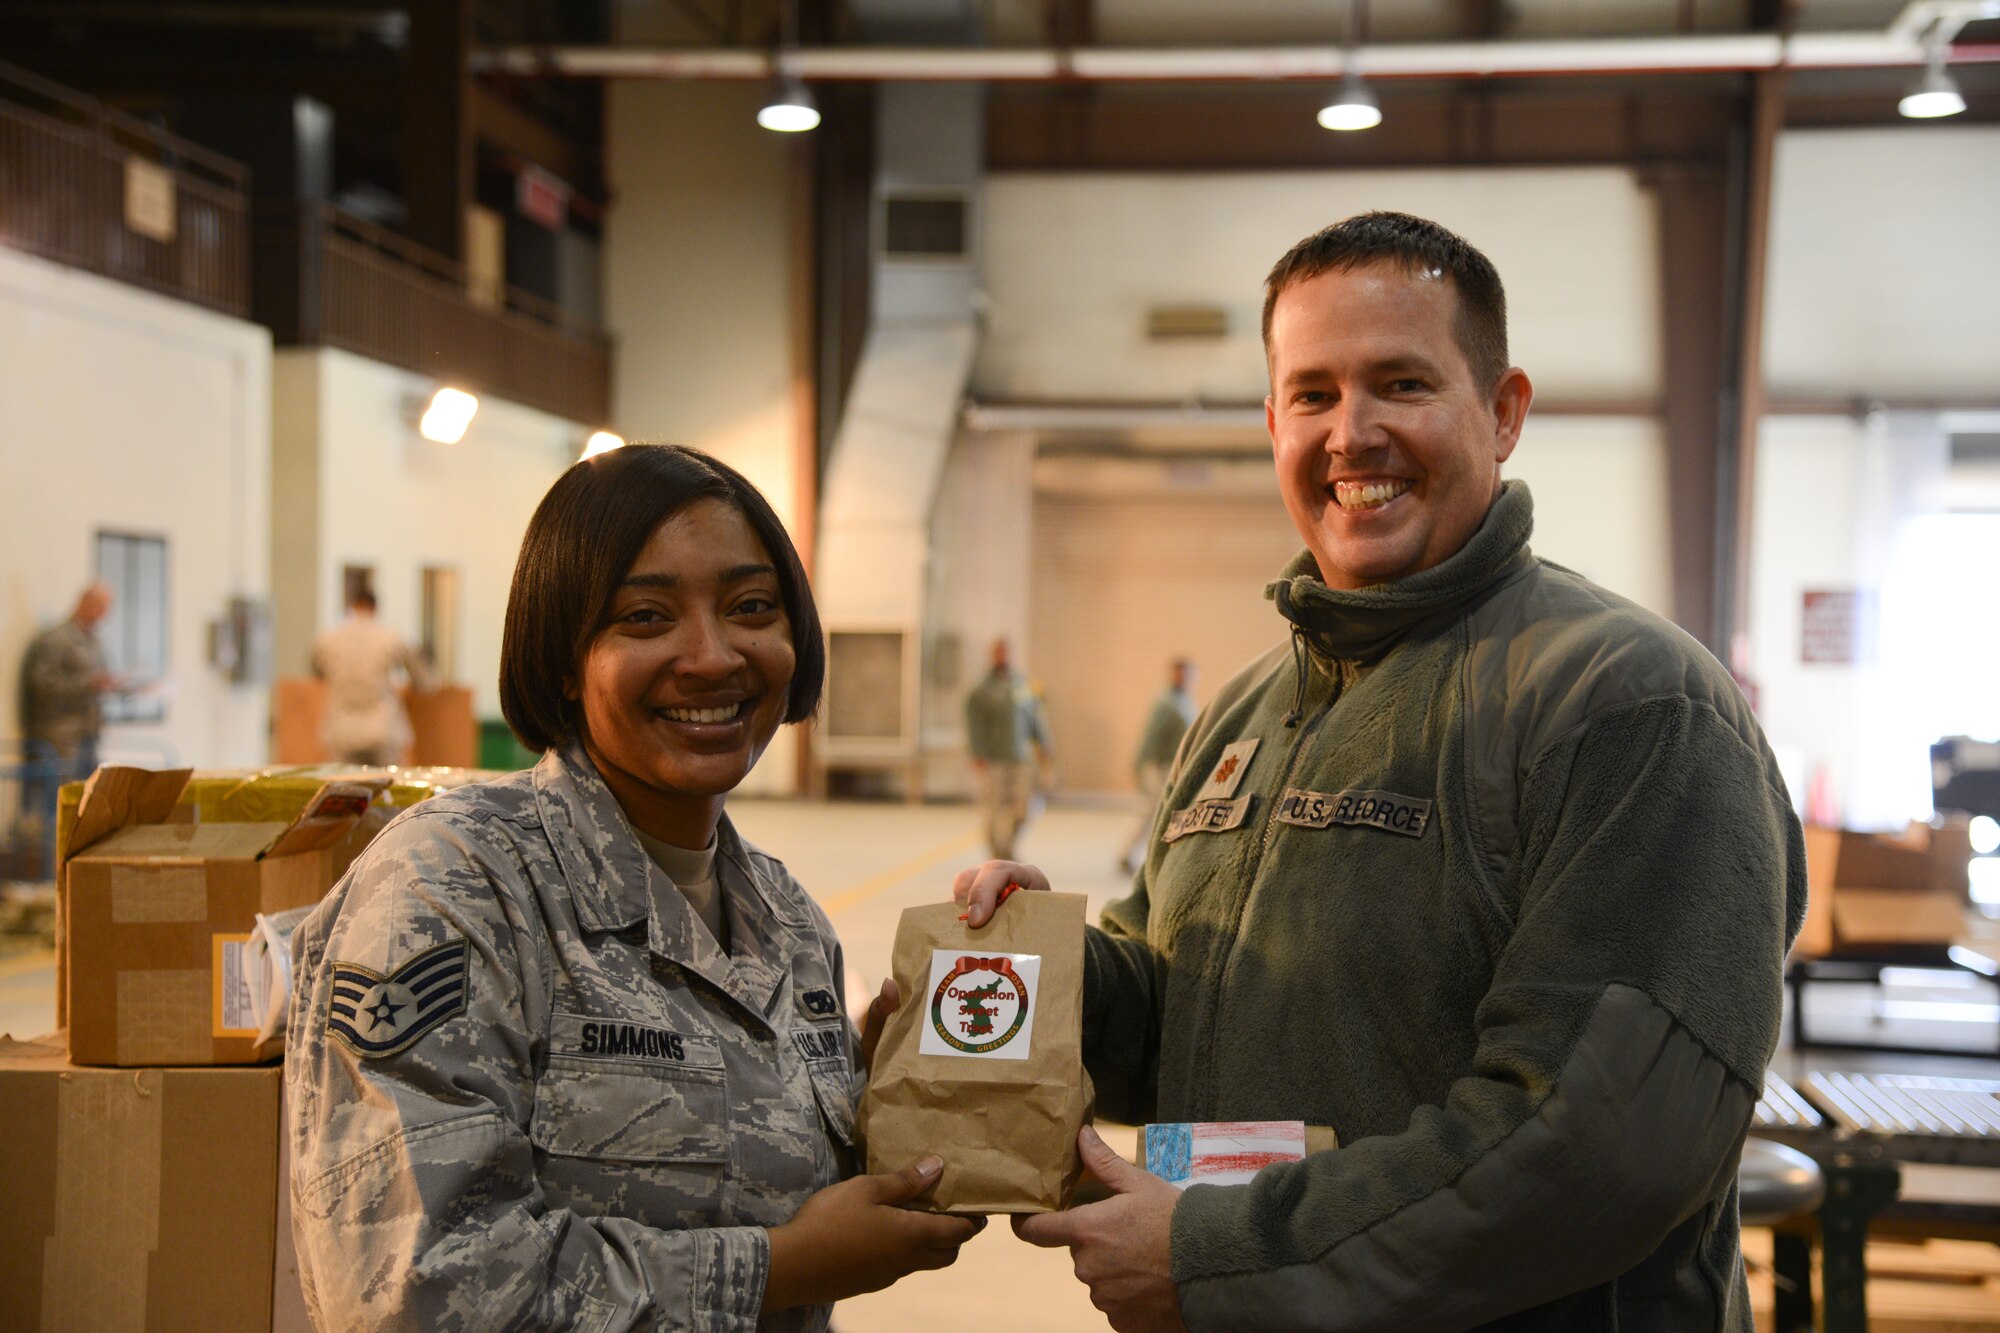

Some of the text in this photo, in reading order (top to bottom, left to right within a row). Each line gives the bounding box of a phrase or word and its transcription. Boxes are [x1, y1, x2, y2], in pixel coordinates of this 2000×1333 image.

[1290, 796, 1325, 822] U.S.
[1352, 797, 1425, 832] FORCE
[938, 973, 1026, 996] TEAM OSAN
[947, 987, 1015, 1001] Operation
[958, 1005, 999, 1017] Sweet
[936, 1023, 1019, 1052] SEASONS GREETINGS
[959, 1021, 994, 1034] Treat
[581, 1022, 685, 1061] SIMMONS
